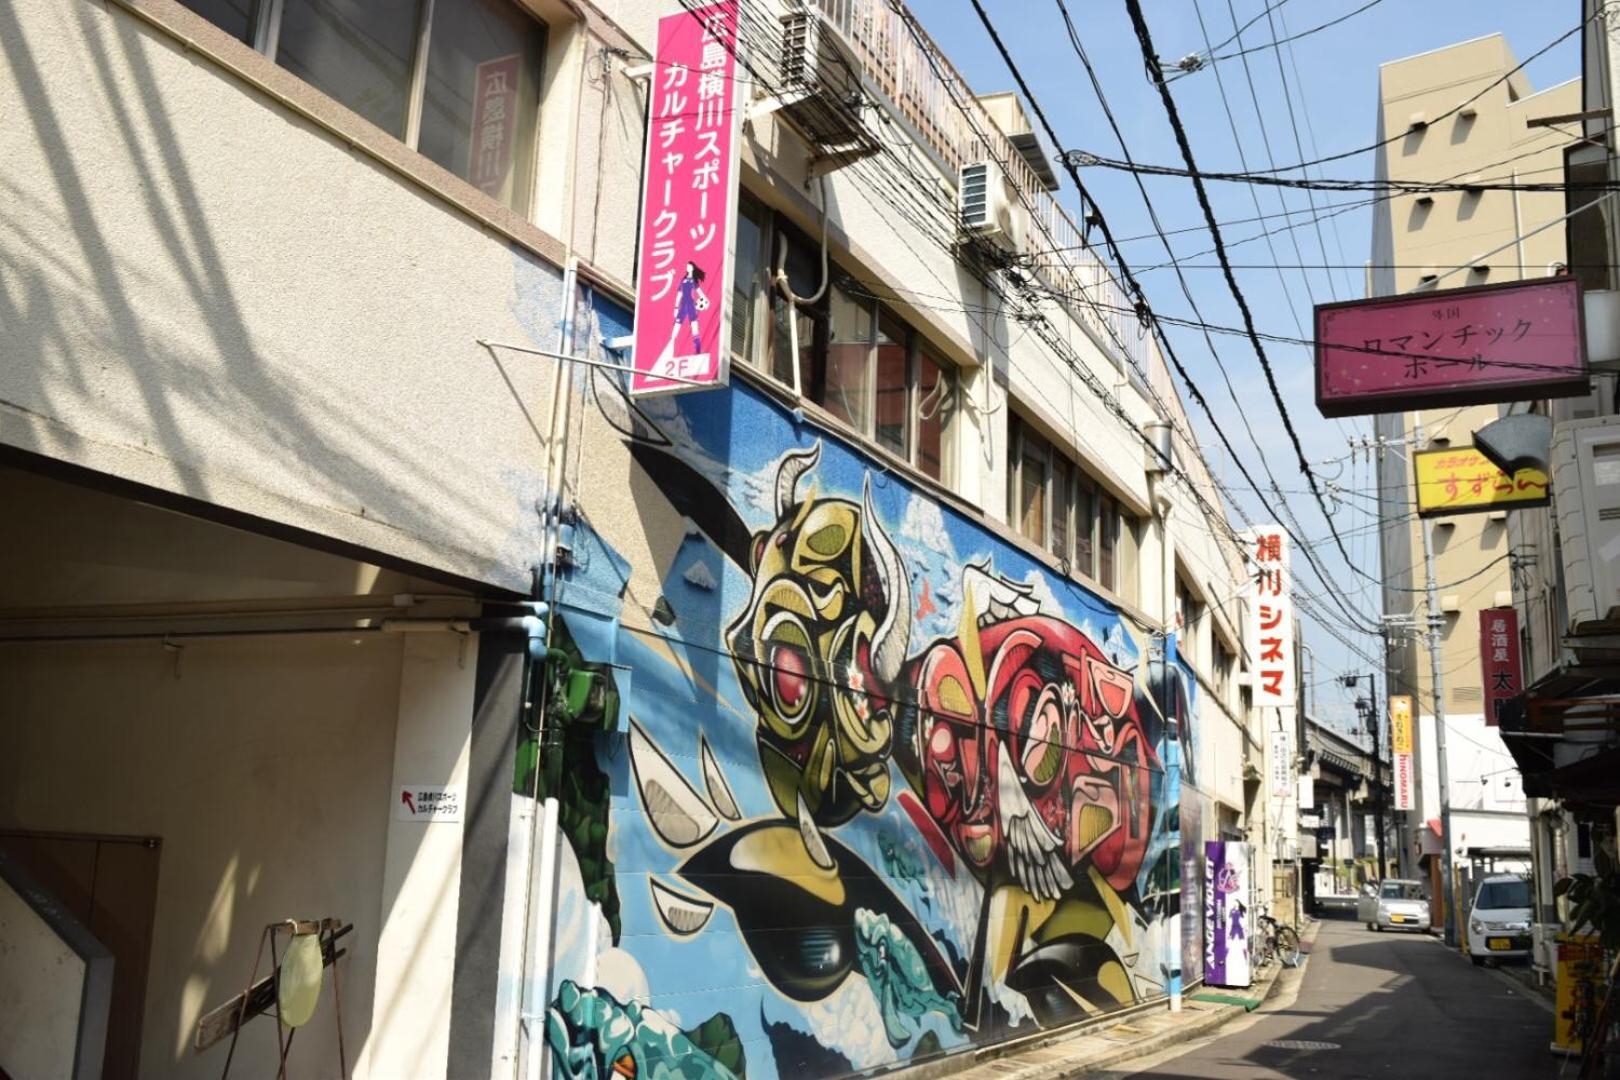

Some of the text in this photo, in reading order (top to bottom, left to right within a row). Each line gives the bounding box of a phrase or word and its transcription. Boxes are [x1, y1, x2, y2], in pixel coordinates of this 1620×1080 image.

[690, 12, 728, 251] 広島横川スポーツ
[651, 62, 689, 301] カルチャークラブ
[665, 359, 688, 378] 2F
[1363, 318, 1532, 351] ロマンチック
[1404, 354, 1488, 379] ホール
[1256, 534, 1284, 697] 横川シネマ
[1491, 618, 1510, 662] 居酒屋
[1206, 856, 1216, 970] ANGEVIOLET
